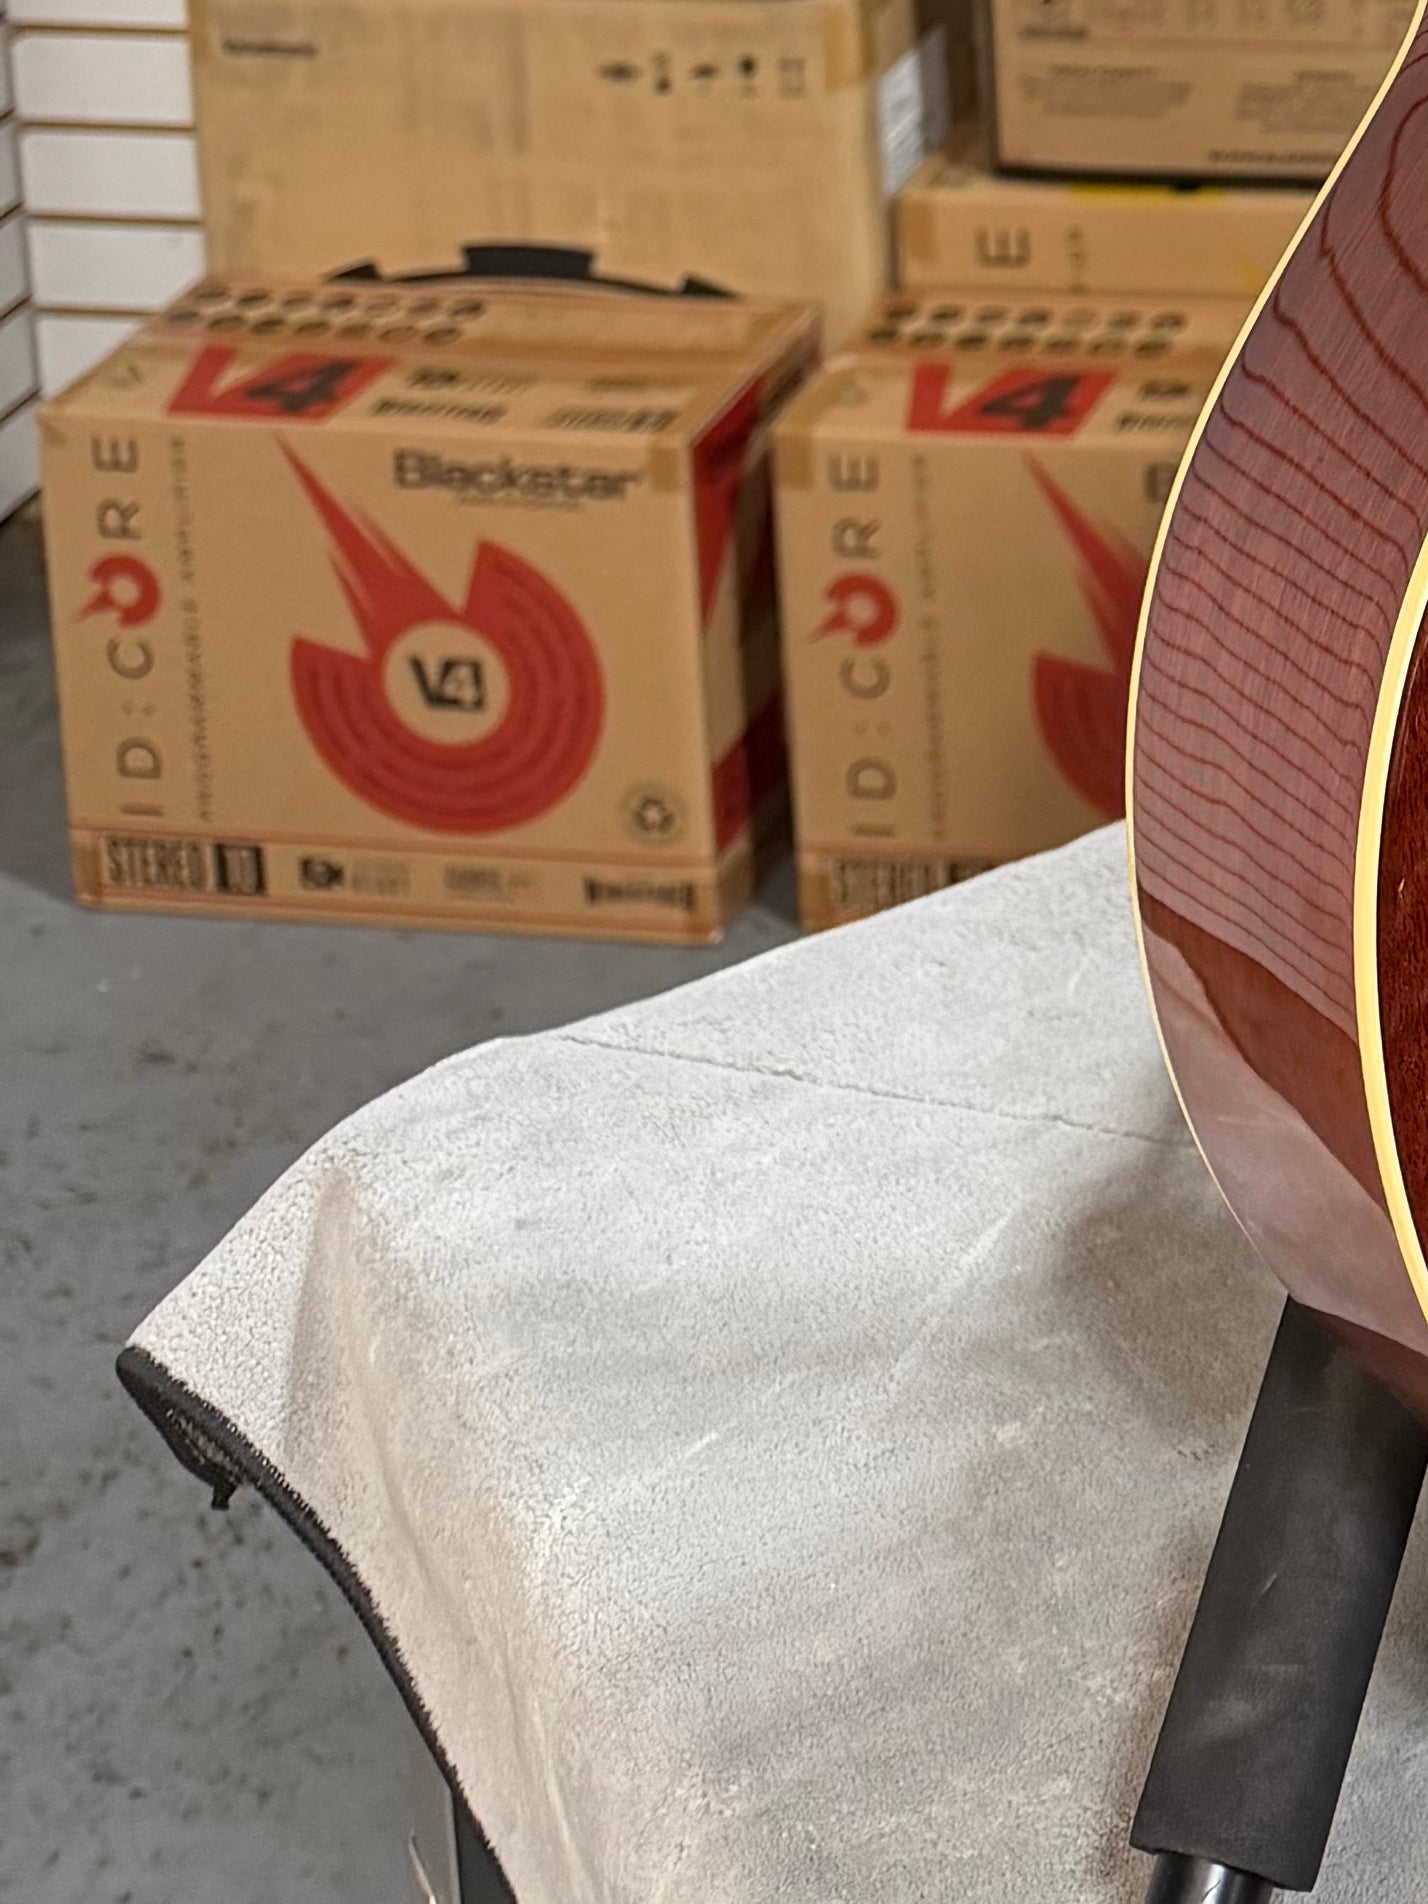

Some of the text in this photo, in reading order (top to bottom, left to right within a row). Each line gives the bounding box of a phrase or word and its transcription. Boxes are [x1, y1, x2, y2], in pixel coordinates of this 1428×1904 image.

[166, 344, 398, 424] V4
[905, 363, 1118, 439] V4
[392, 445, 642, 501] Blackstar
[106, 837, 203, 889] STEREO
